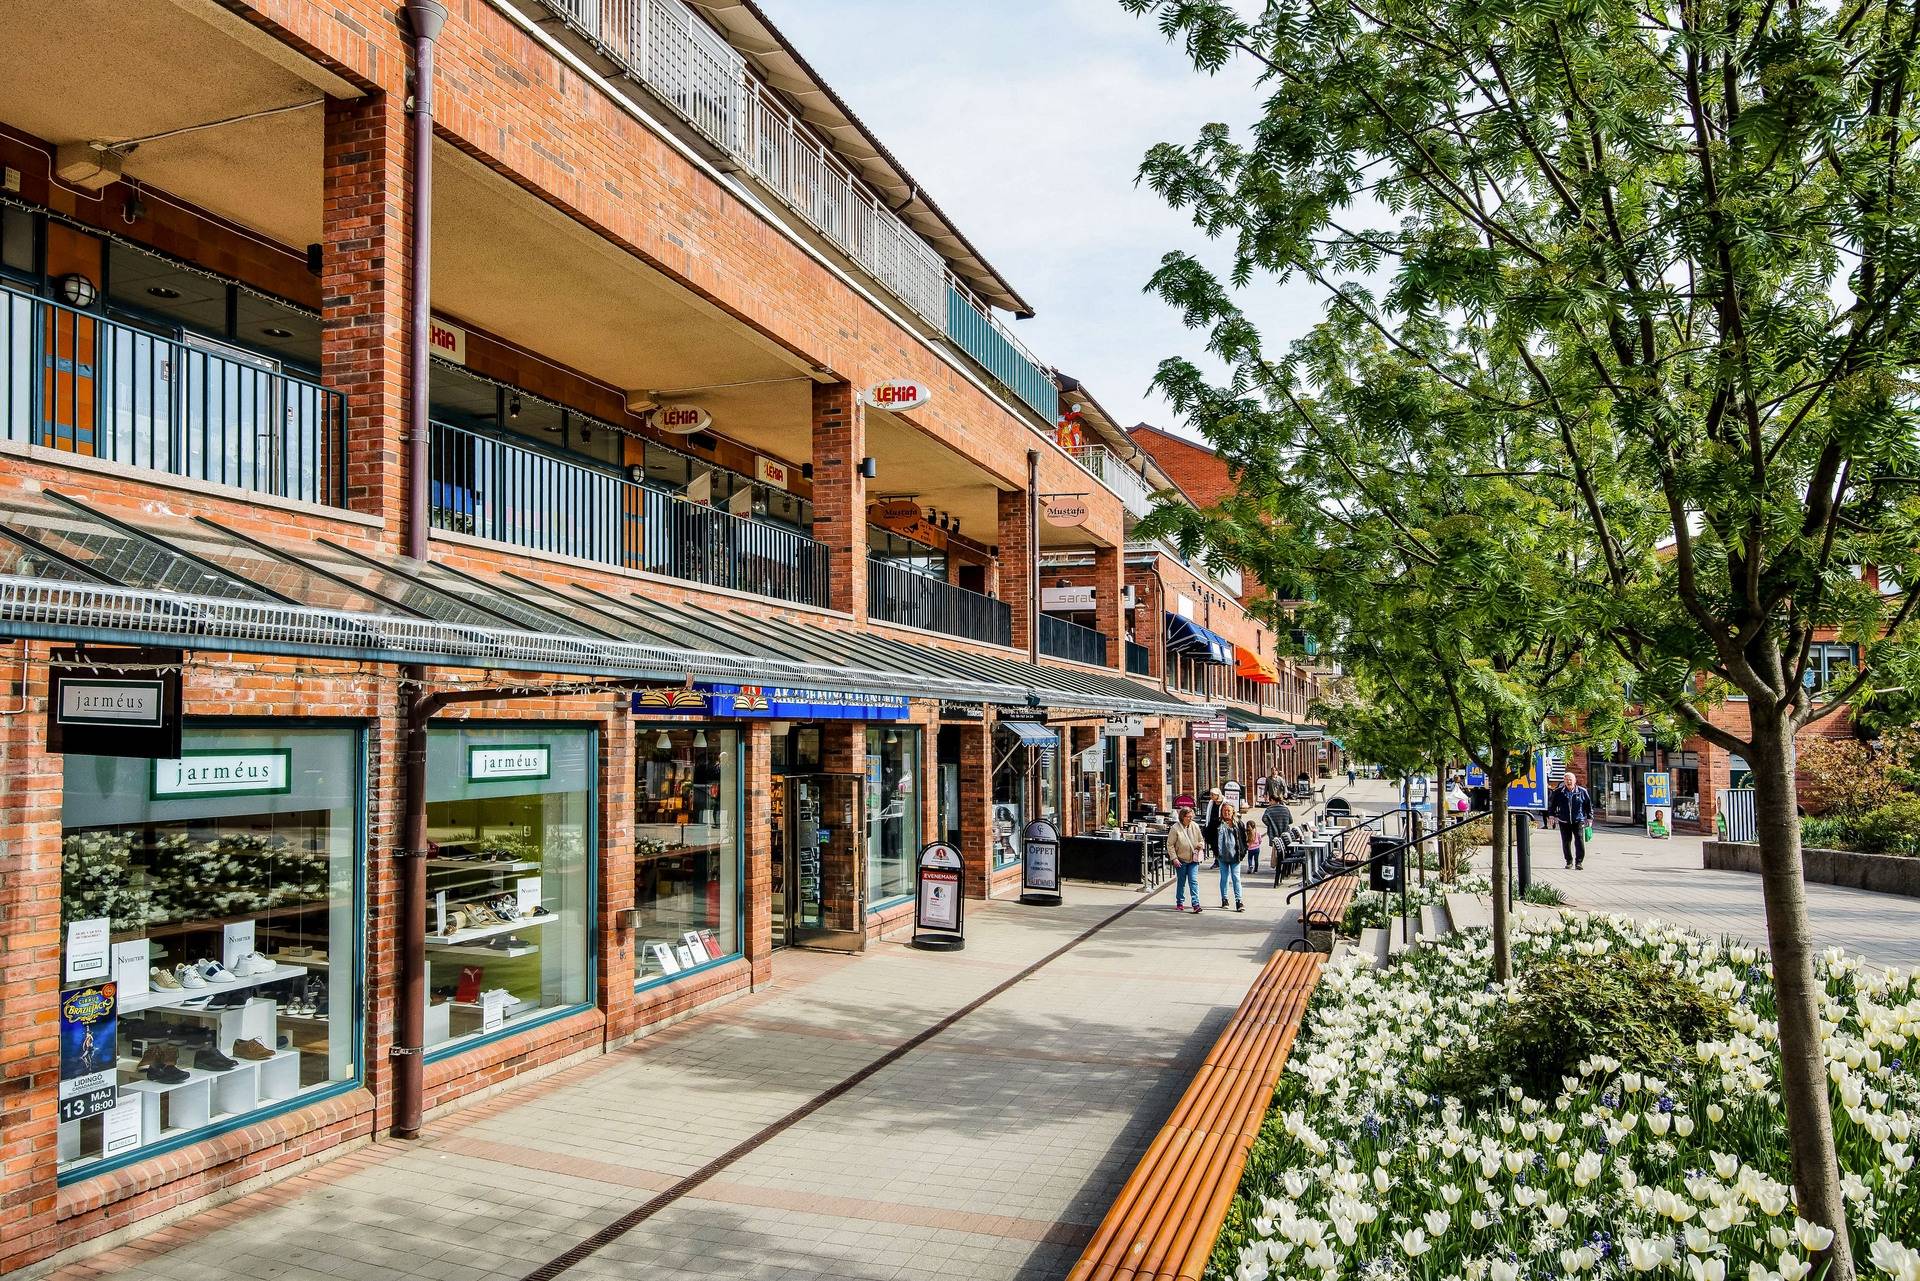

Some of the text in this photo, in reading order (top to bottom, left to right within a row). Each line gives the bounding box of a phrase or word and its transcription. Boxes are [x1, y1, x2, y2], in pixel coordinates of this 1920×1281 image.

[885, 508, 918, 516] Mustafa
[1047, 507, 1085, 516] Mustafa
[75, 690, 144, 712] jarméus
[483, 753, 538, 773] jarméus
[176, 761, 270, 787] jarméus
[74, 1073, 103, 1087] LIDINGÖ
[91, 1088, 112, 1101] MAJ
[63, 1099, 85, 1118] 13
[89, 1099, 114, 1112] 18:00
